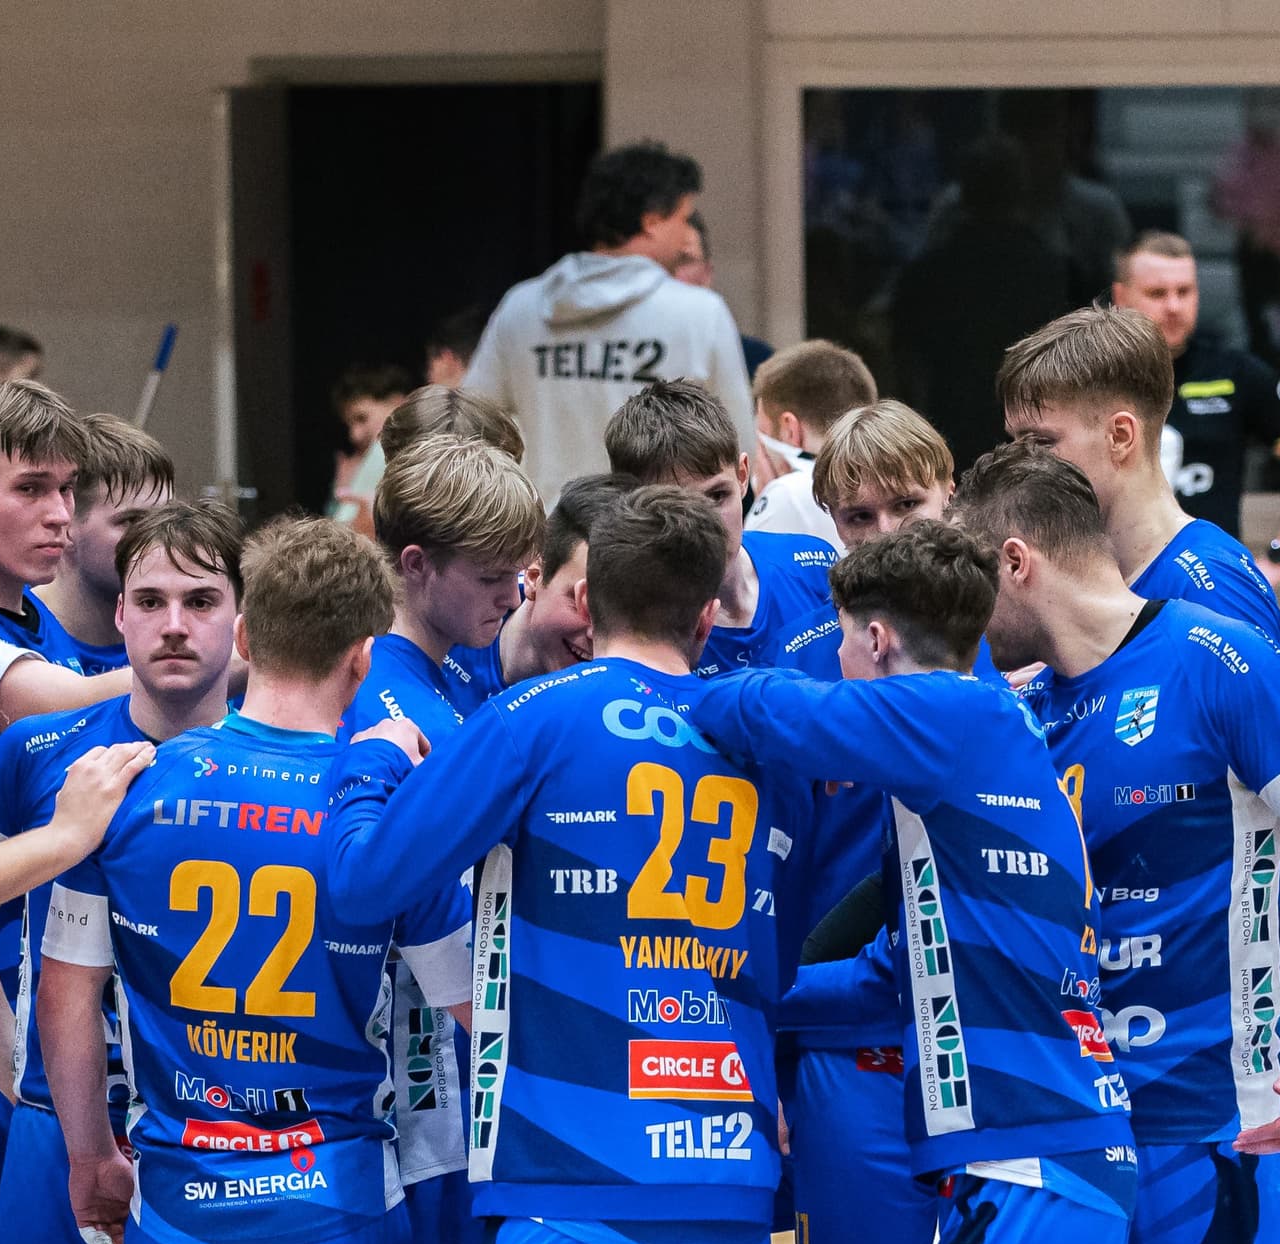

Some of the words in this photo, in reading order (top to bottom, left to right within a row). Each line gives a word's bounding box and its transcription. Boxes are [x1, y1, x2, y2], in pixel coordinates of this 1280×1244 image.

[533, 339, 667, 383] TELE2
[793, 551, 827, 562] ANIJA
[1192, 561, 1215, 591] VALD
[784, 629, 816, 654] ANIJA
[815, 618, 839, 636] VAL
[1188, 625, 1223, 647] ANIJA
[1222, 643, 1250, 675] VALD
[378, 688, 406, 721] LAAD
[506, 672, 580, 712] HORIZON
[1020, 681, 1045, 693] ALD
[24, 731, 60, 752] ANIJA
[227, 763, 321, 785] primend
[1114, 784, 1173, 806] Mobil
[152, 799, 322, 836] LIFTREN
[626, 762, 759, 930] 23
[981, 848, 1050, 877] TRB
[550, 868, 618, 895] TRB
[1112, 886, 1160, 902] Bag
[50, 905, 89, 926] mend
[112, 911, 159, 937] RIMARK
[478, 892, 494, 958] NORDECON
[902, 861, 919, 928] NORDECON
[911, 933, 925, 979] BETOON
[1241, 900, 1252, 946] BETOON
[168, 860, 317, 1018] 22
[473, 963, 486, 1011] BETOON
[1240, 969, 1253, 1032] NORDECON
[628, 988, 724, 1025] Mobil
[186, 1019, 298, 1064] KÕVERIK
[919, 997, 934, 1062] NORDECON
[434, 1048, 450, 1110] NORDECON
[641, 1056, 716, 1078] CIRCLE
[175, 1070, 268, 1117] Mobil
[925, 1066, 939, 1112] BETOON
[192, 1134, 274, 1153] CIRCLE
[645, 1111, 754, 1161] TELE2
[184, 1181, 218, 1202] SW
[224, 1171, 328, 1198] ENERGIA
